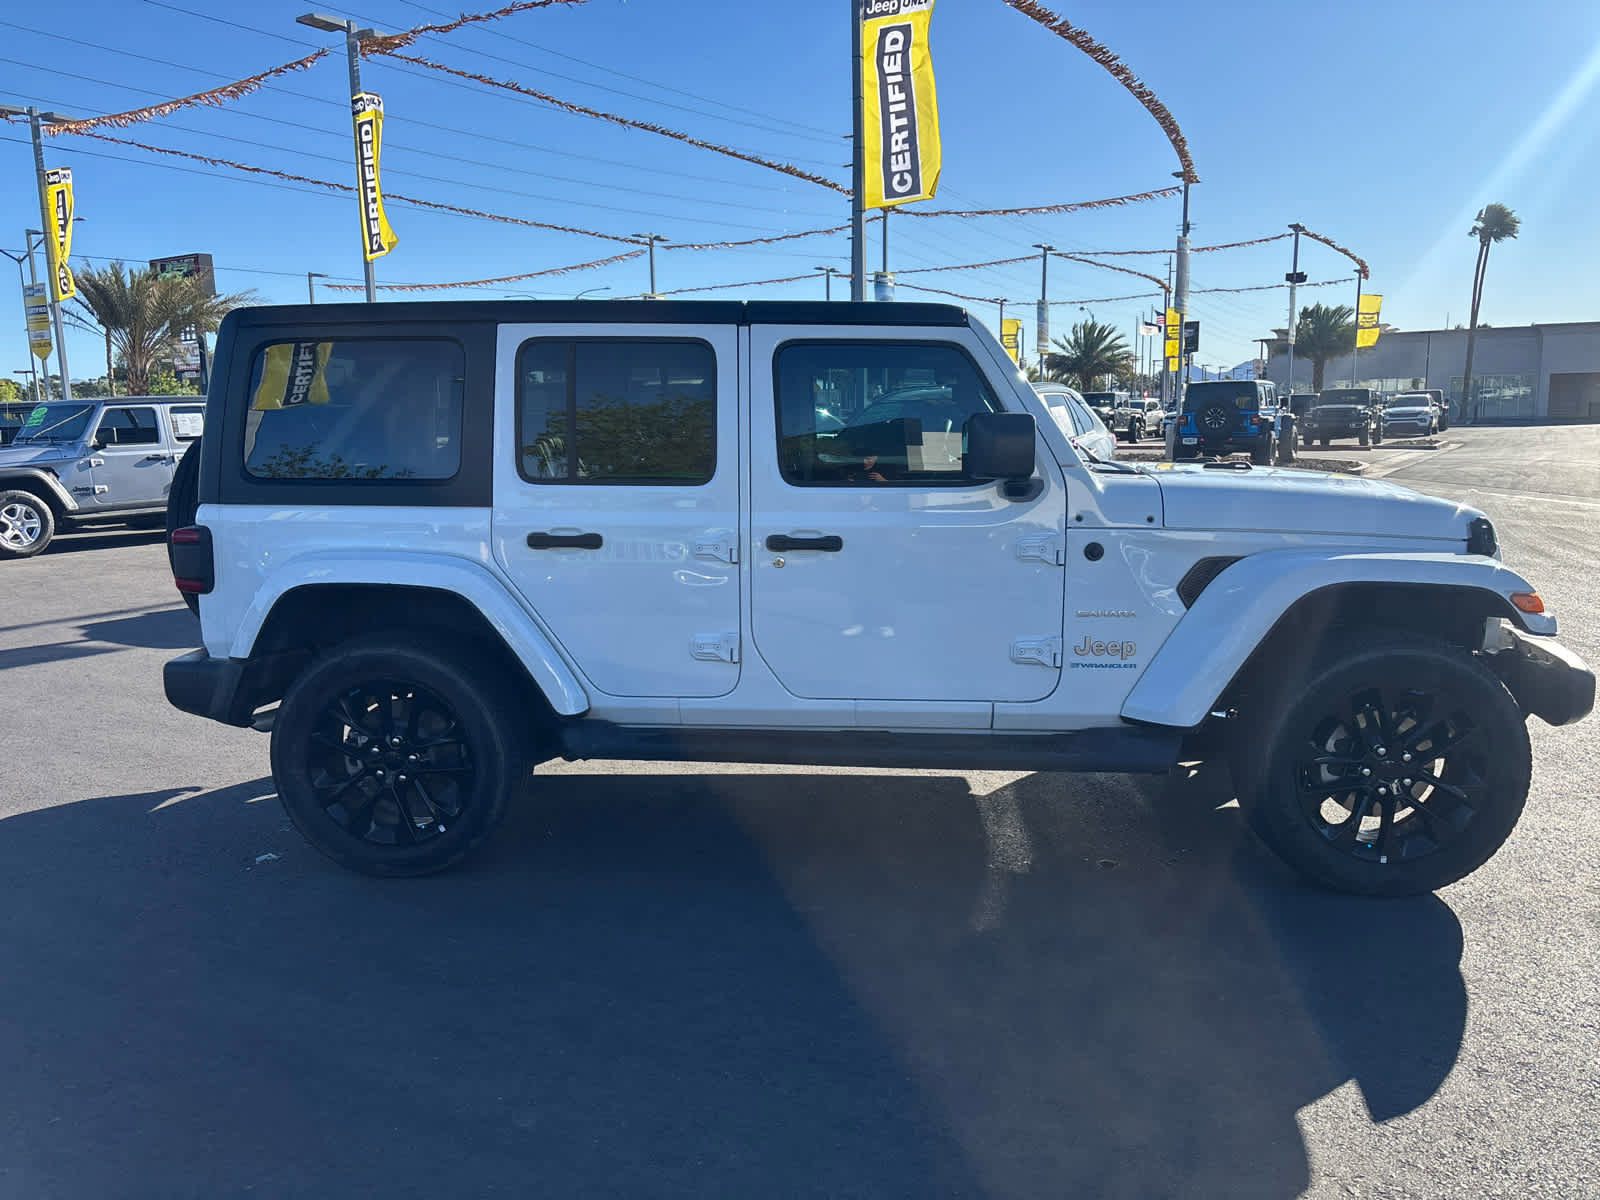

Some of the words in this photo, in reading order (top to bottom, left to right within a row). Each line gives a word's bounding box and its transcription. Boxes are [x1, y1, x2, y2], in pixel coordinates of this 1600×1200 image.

[866, 0, 898, 14] Jeep
[882, 30, 913, 193] CERTIFIED
[1074, 635, 1136, 660] Jeep
